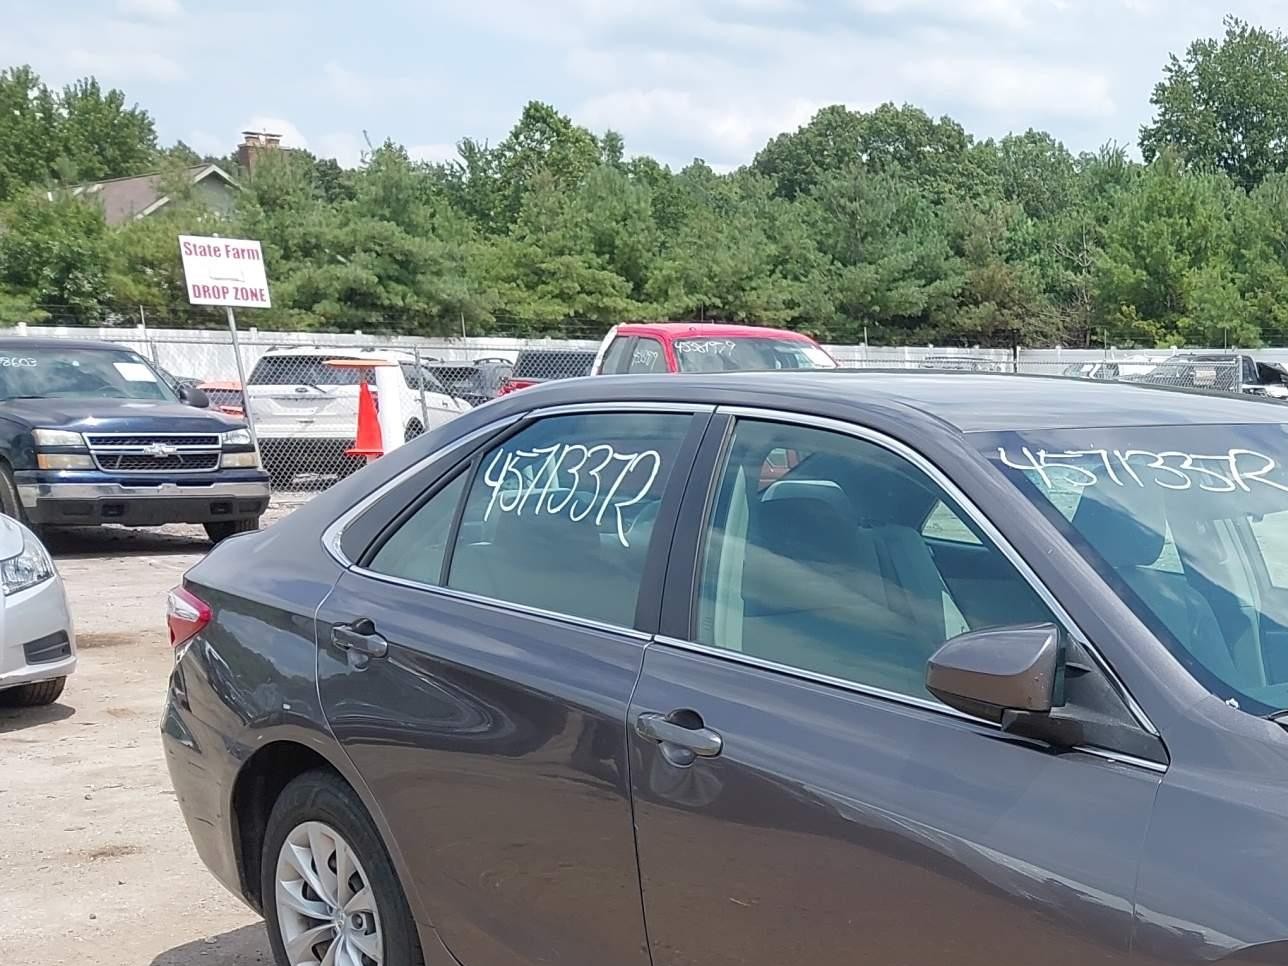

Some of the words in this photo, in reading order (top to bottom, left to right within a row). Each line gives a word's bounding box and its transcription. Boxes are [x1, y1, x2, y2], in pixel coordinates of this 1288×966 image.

[183, 241, 221, 258] State
[224, 244, 260, 261] Farm
[191, 284, 229, 300] DROP
[232, 286, 267, 302] ZONE
